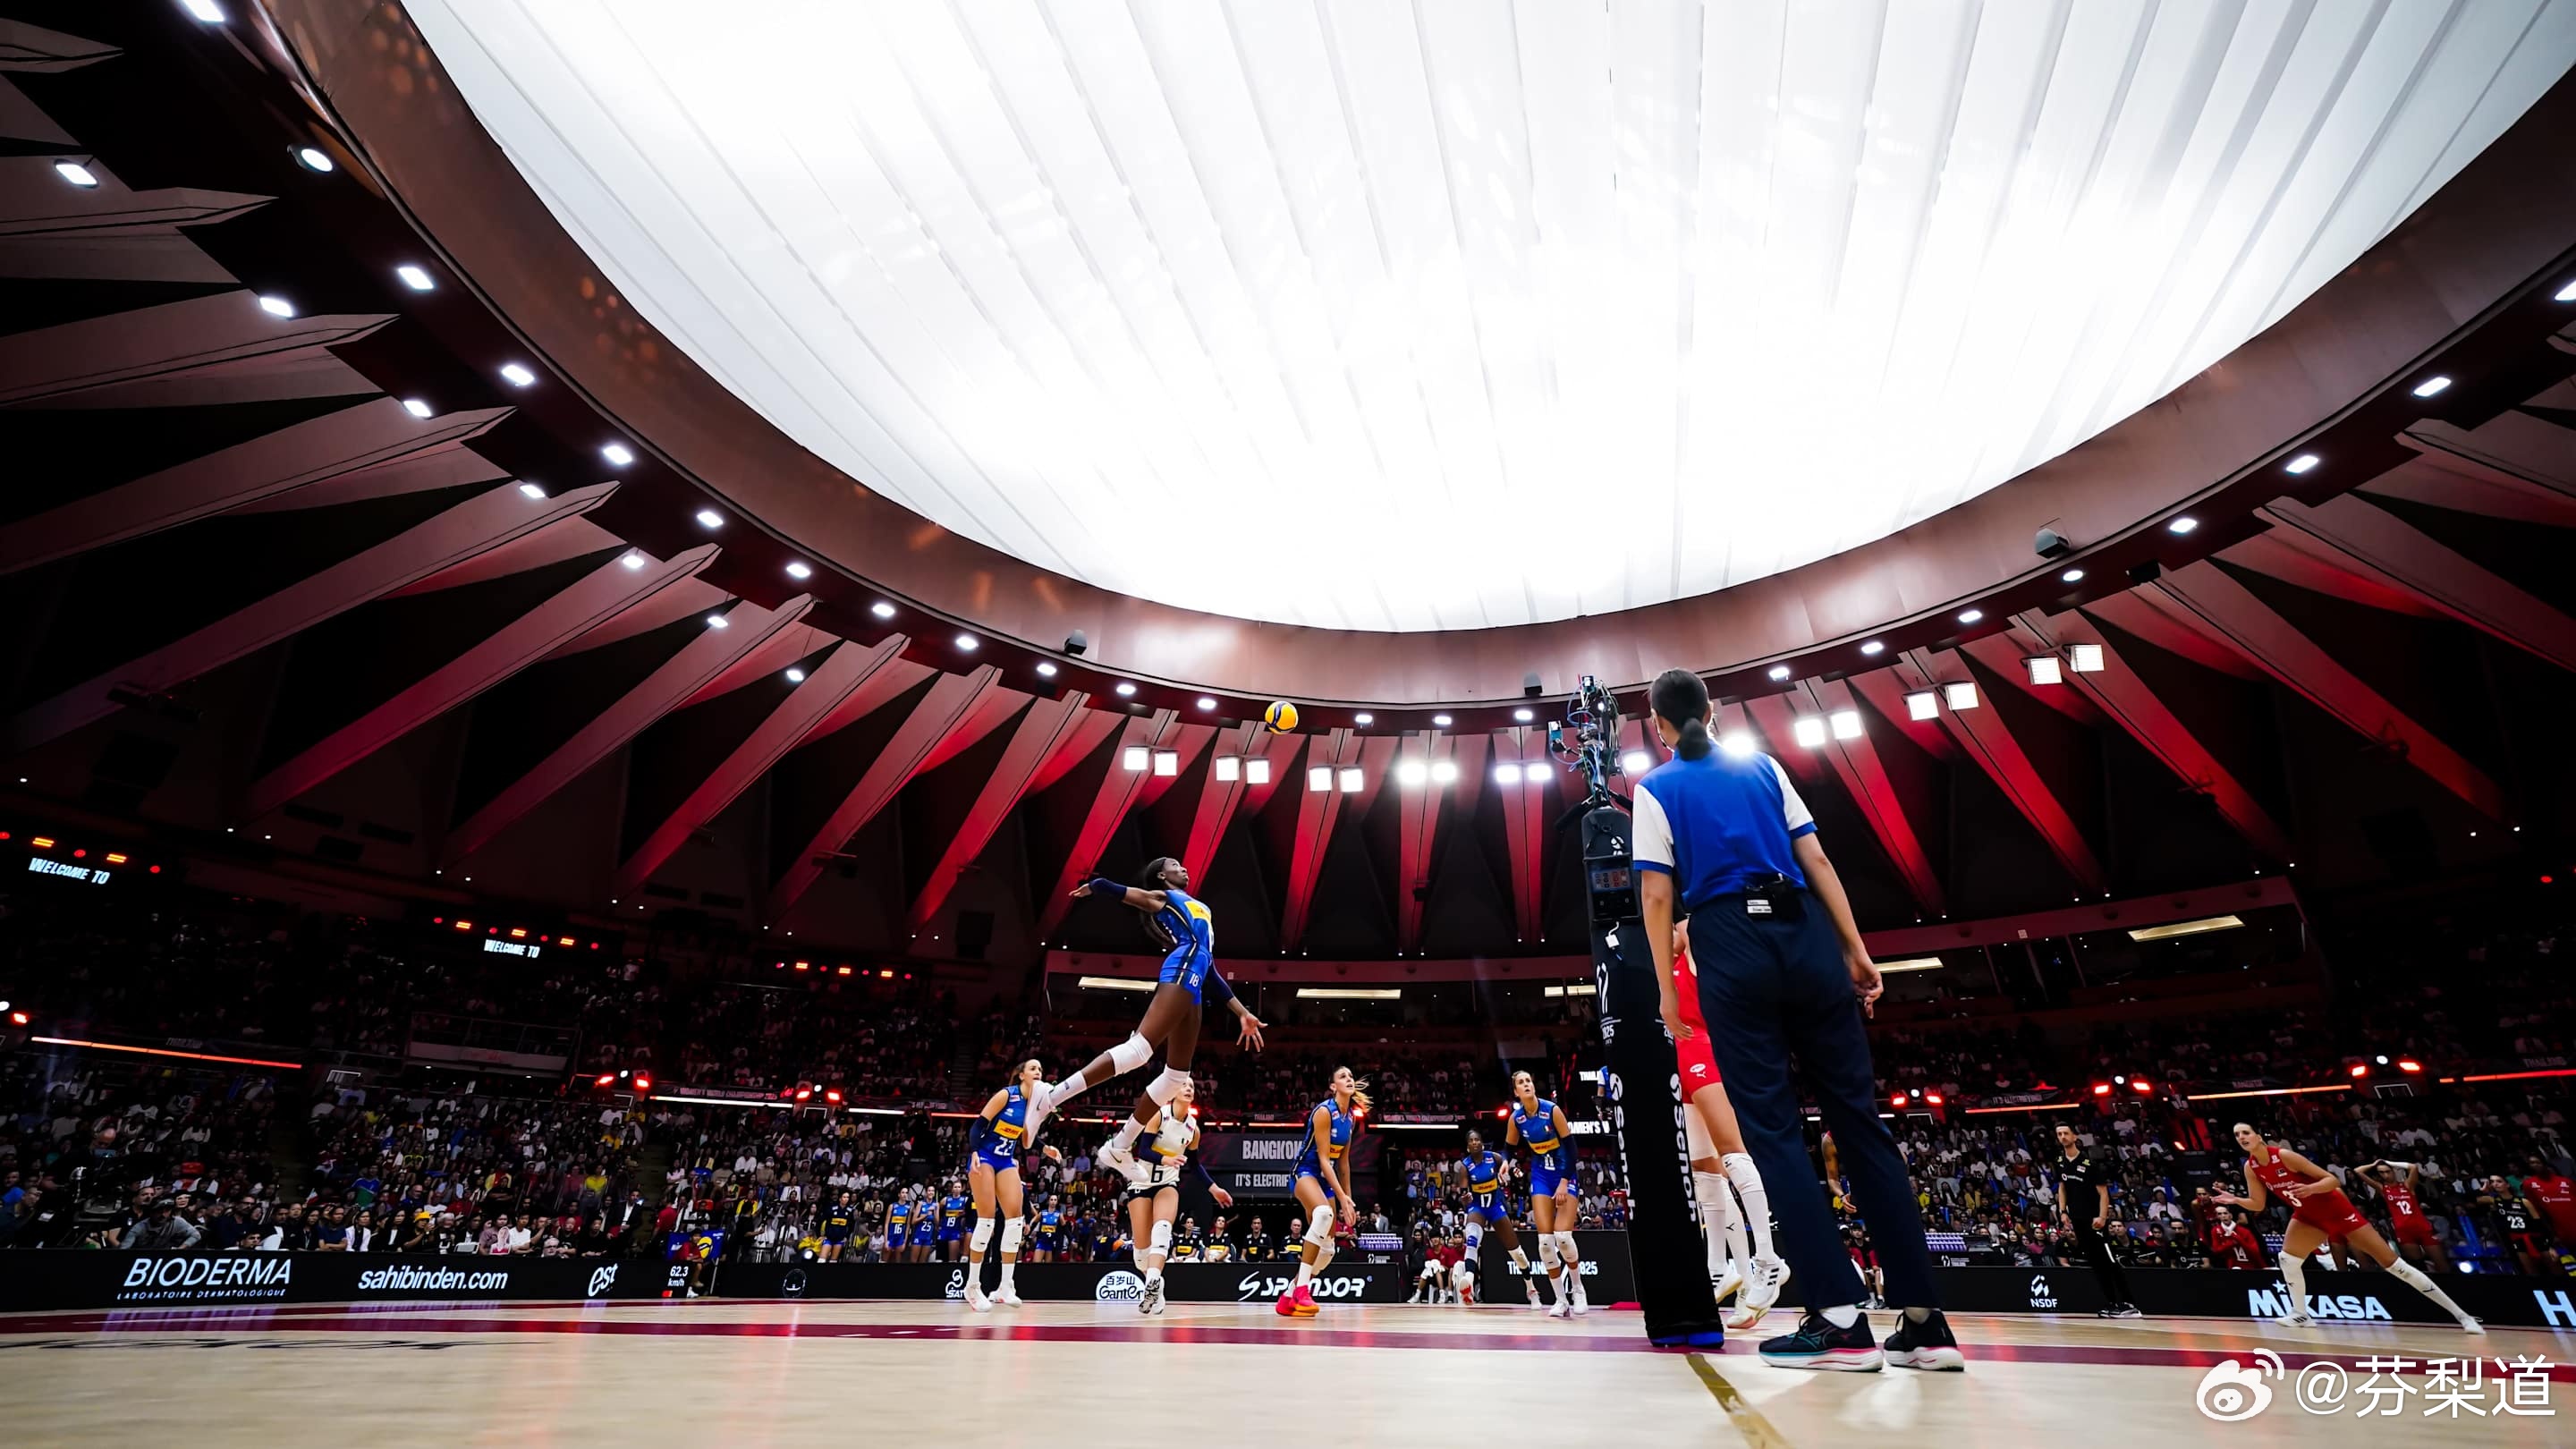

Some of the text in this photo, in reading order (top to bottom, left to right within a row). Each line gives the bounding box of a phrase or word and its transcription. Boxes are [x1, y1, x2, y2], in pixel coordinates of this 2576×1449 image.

[29, 858, 110, 885] WELCOME TO
[484, 939, 540, 958] WELCOME TO
[1189, 972, 1199, 987] 18
[1567, 1121, 1601, 1134] OMEN'S
[1674, 1105, 1697, 1223] Senoh
[1235, 1174, 1291, 1187] IT'S ELECTRIF
[1480, 1193, 1492, 1208] 17
[2396, 1200, 2412, 1215] 12
[894, 1224, 902, 1234] 16
[921, 1222, 932, 1232] 25
[947, 1217, 956, 1227] 19
[2507, 1215, 2526, 1230] 23
[123, 1258, 291, 1286] BIODERMA
[670, 1266, 688, 1277] 62.3
[1579, 1261, 1598, 1275] 025
[358, 1265, 508, 1290] sahibinden.com
[667, 1278, 684, 1287] km/h
[1106, 1275, 1136, 1286] 百岁山
[117, 1289, 286, 1300] LABORATOIRE DERMATOLOGIQUE
[1260, 1277, 1366, 1298] SPNSOR
[2030, 1299, 2057, 1308] NSDF
